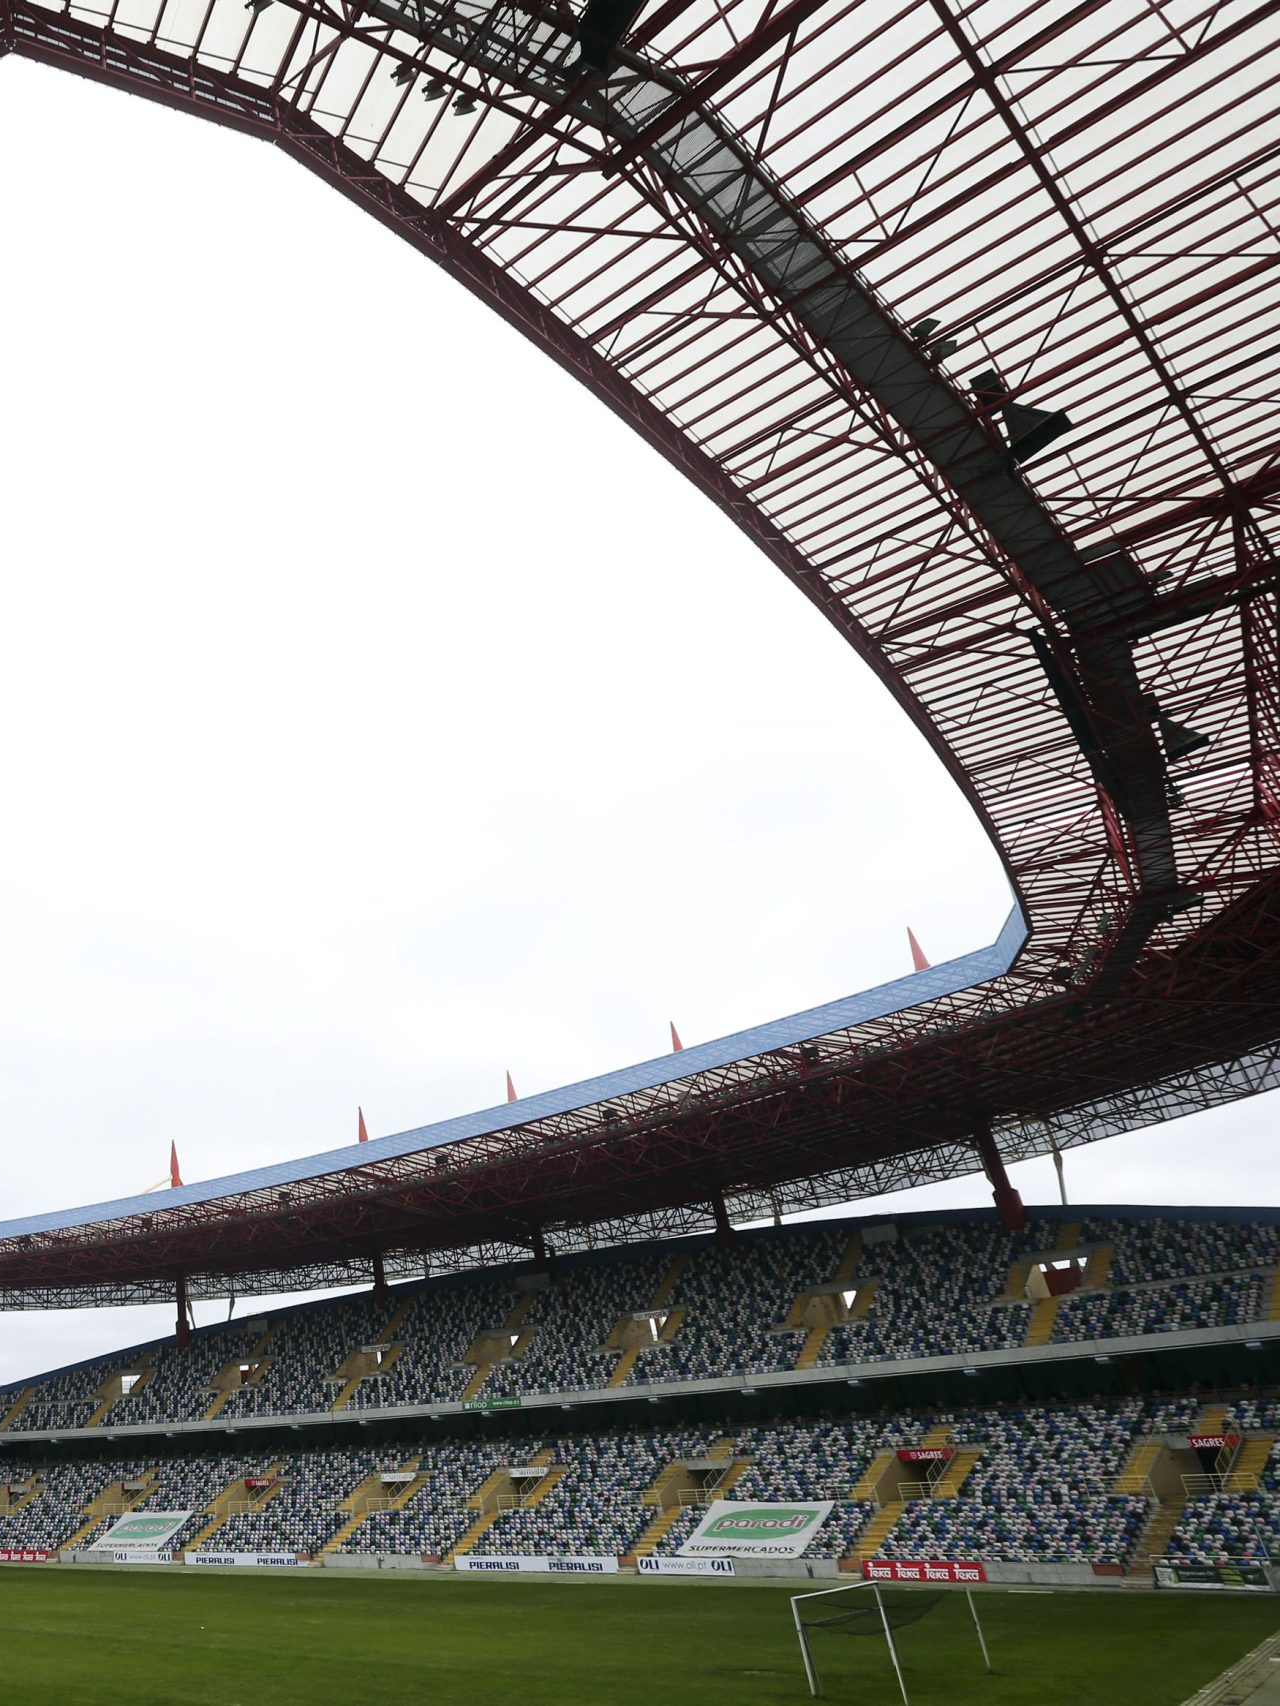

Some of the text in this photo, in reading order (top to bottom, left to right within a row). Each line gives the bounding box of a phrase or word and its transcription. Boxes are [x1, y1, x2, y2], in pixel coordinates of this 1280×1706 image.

[1191, 1437, 1225, 1448] SAGRES
[916, 1450, 943, 1460] SAGRES
[712, 1514, 810, 1532] paradi
[688, 1545, 797, 1554] SUPERMERCADOS
[114, 1552, 127, 1561] OLI
[158, 1552, 171, 1561] OLI
[195, 1557, 235, 1565] PIERALISI
[256, 1558, 299, 1566] PIERALISI
[469, 1561, 520, 1570] PIERALISI
[639, 1558, 733, 1572] OLI www.oli.pt OLI
[548, 1562, 603, 1572] PIERALISI
